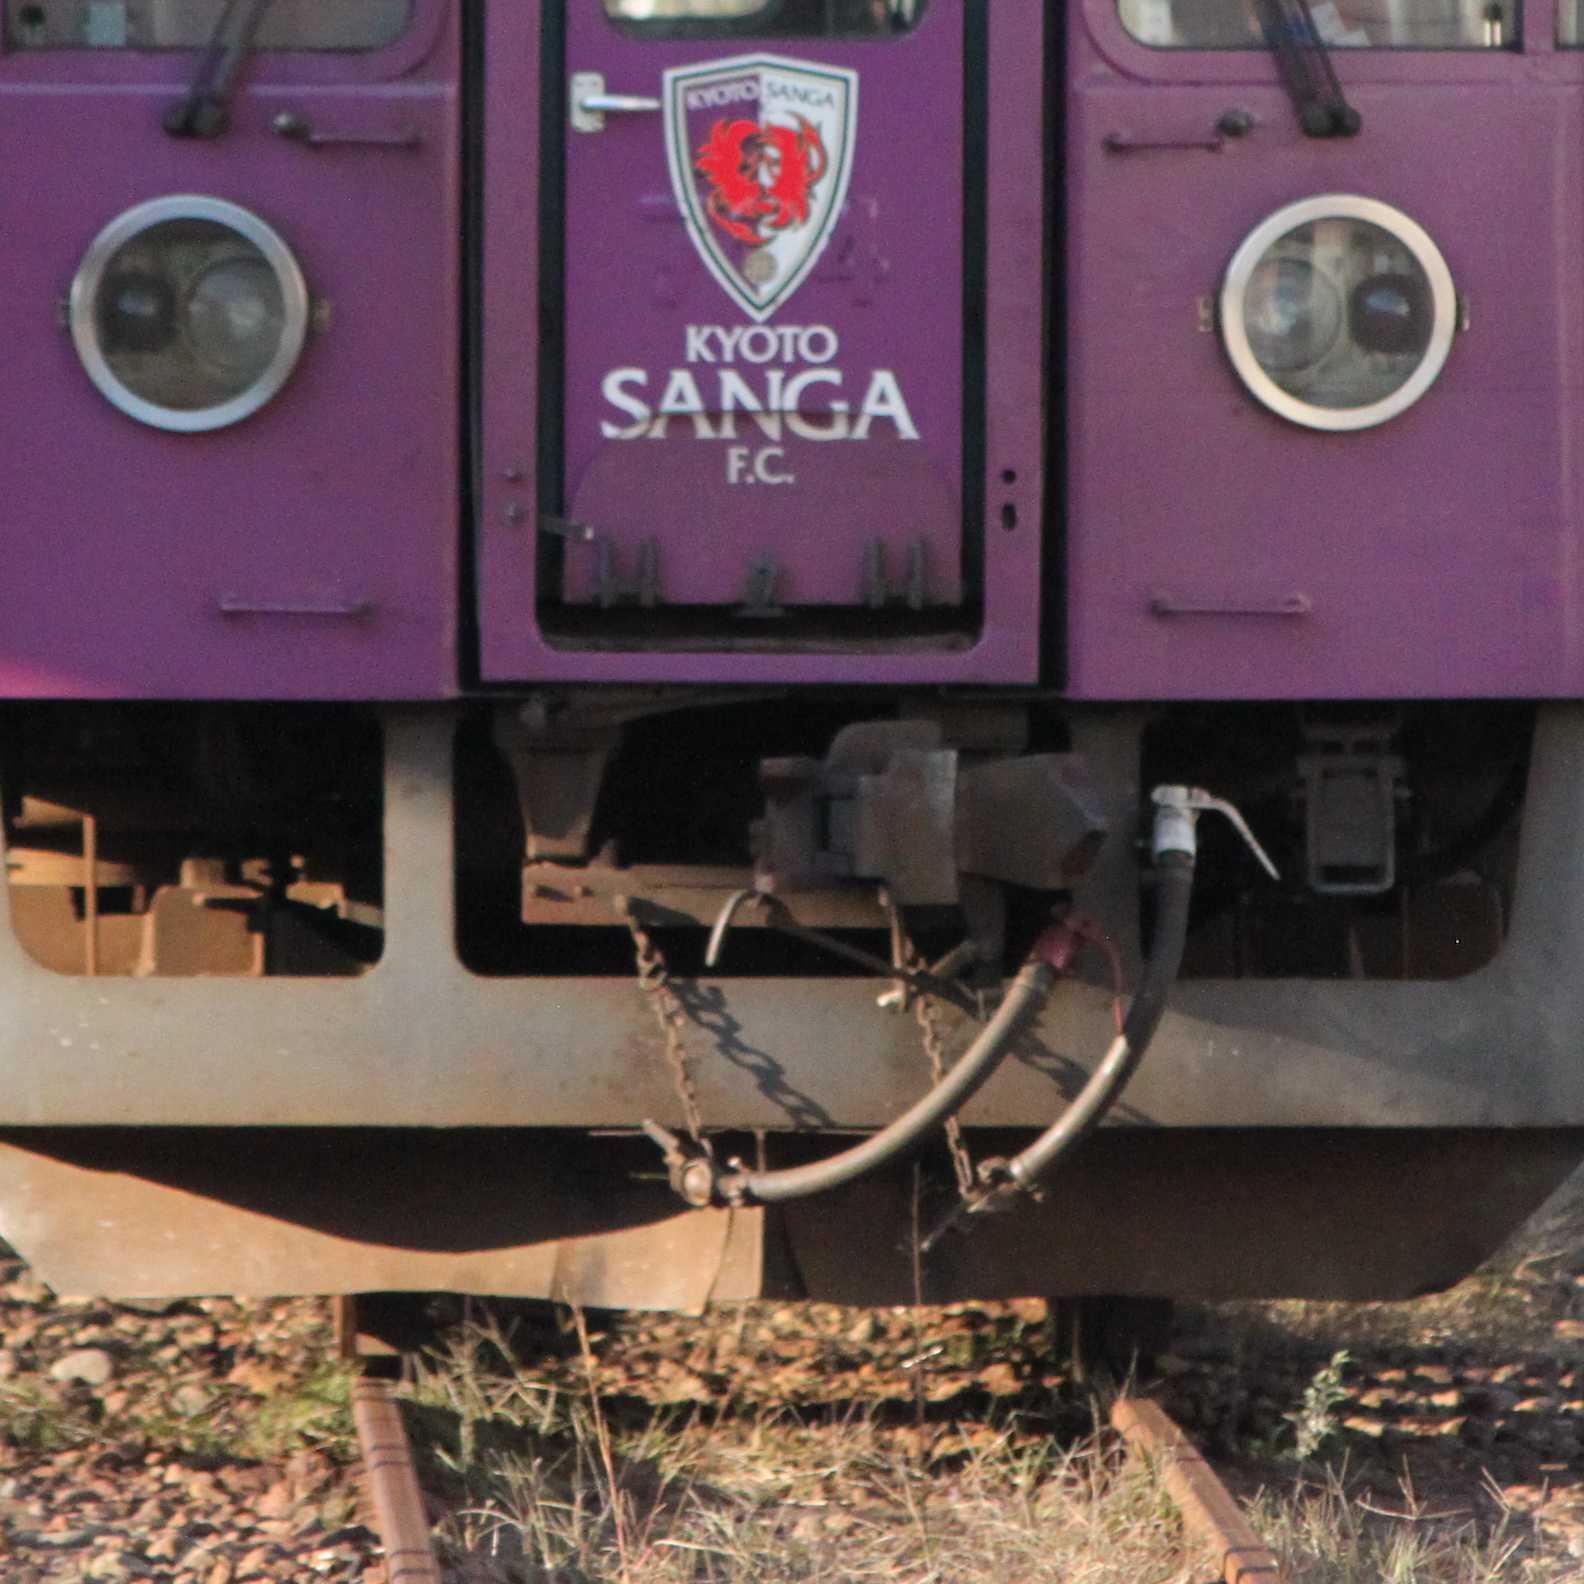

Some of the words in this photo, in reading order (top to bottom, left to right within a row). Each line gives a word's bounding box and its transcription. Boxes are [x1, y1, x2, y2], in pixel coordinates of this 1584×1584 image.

[687, 81, 759, 110] KYOTO
[767, 81, 835, 109] SANGA
[685, 324, 839, 364] KYOTO
[600, 367, 921, 441] SANGA
[726, 445, 795, 484] F.C.
